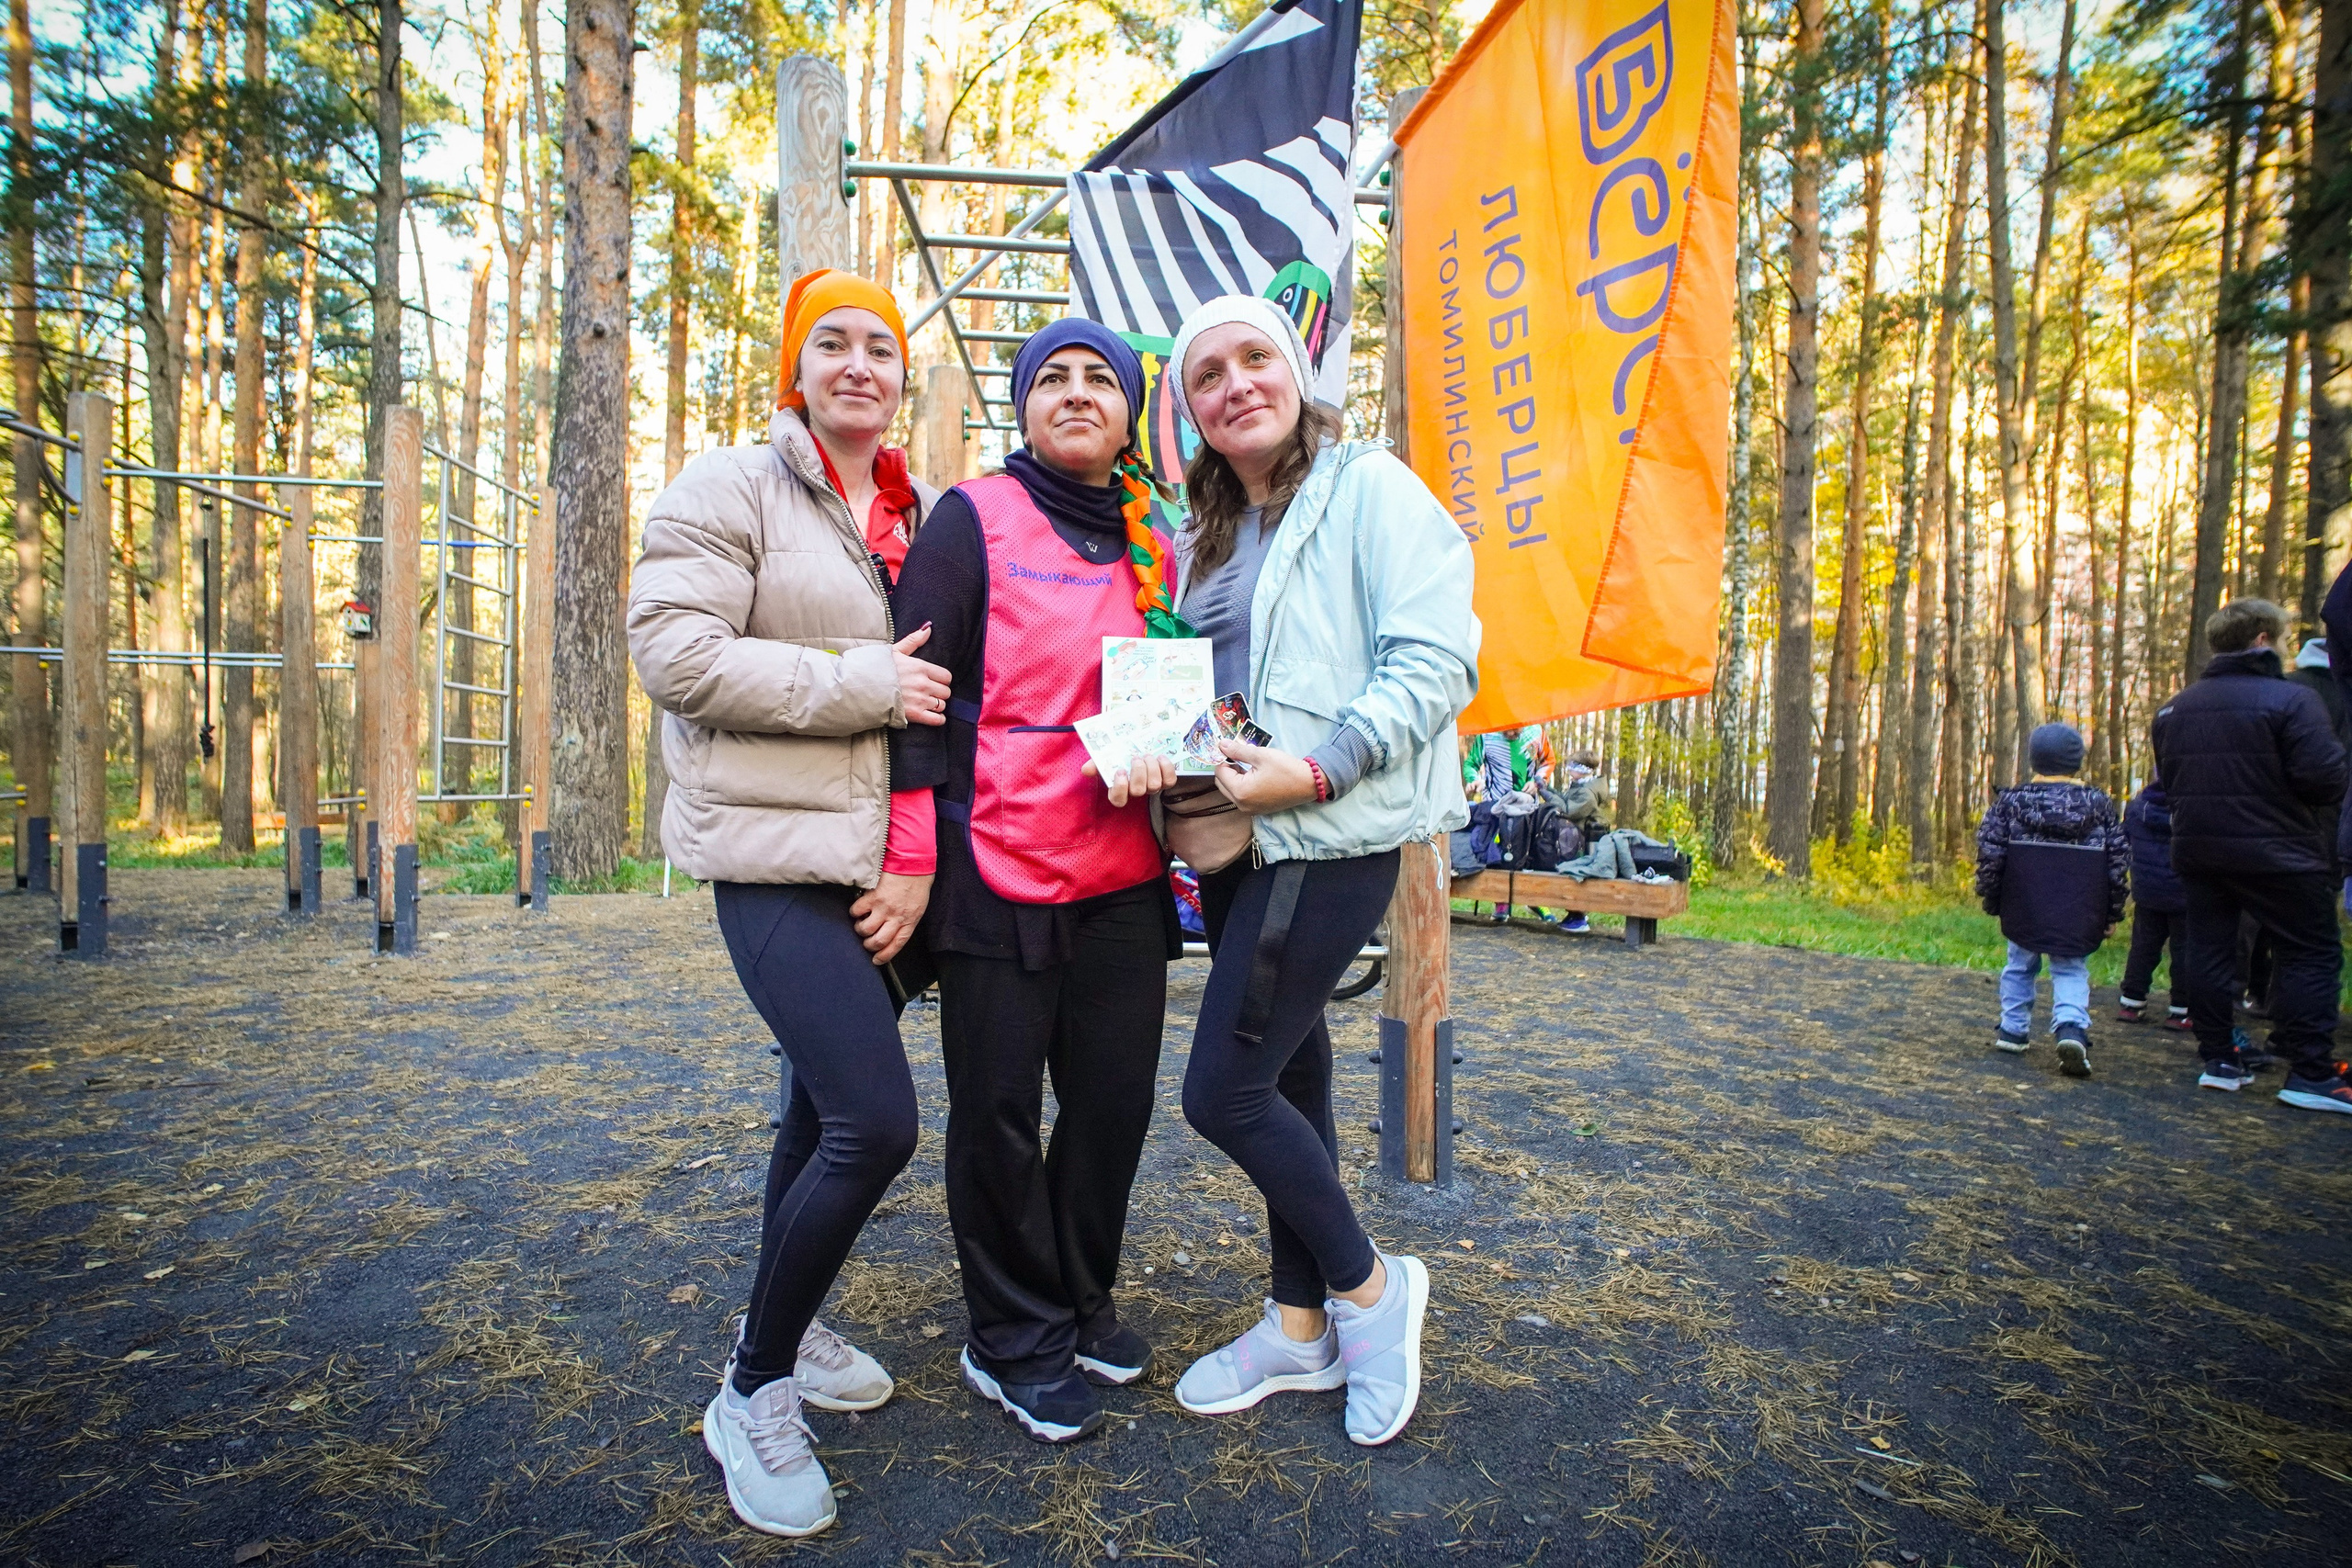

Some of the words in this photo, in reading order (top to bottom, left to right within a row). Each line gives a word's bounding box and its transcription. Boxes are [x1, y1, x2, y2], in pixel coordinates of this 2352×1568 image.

[1439, 228, 1486, 543] ТОМИЛИНСКИЙ
[1480, 184, 1548, 550] ЛЮБЕРЦЫ
[1007, 561, 1113, 587] Замыкающий
